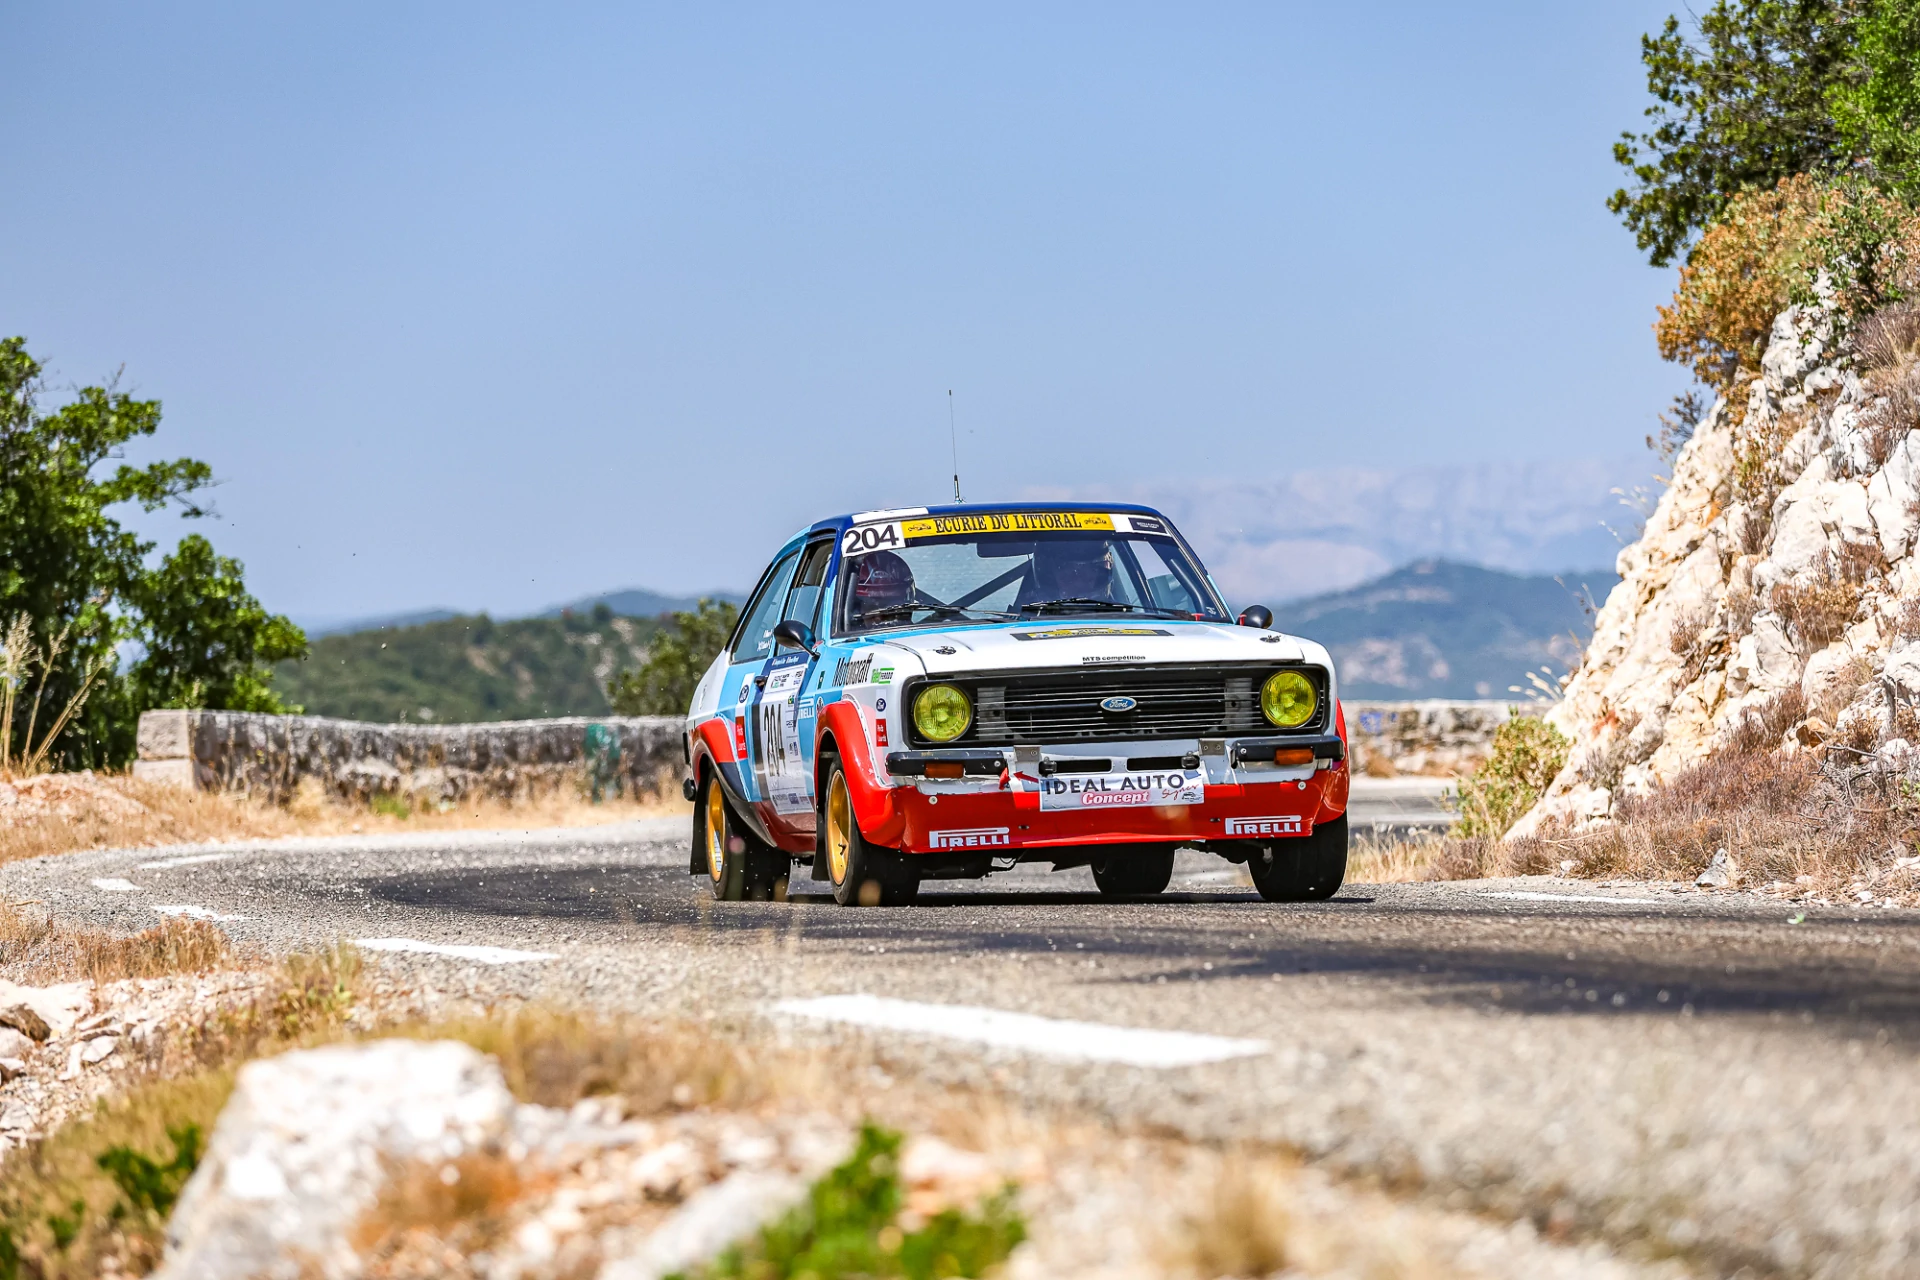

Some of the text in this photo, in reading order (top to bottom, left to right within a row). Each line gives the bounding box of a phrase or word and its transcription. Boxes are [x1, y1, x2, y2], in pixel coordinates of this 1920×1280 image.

[934, 513, 1082, 533] ECURIE DU LITTORAL
[843, 524, 900, 554] 204
[1102, 654, 1146, 662] compétition
[832, 653, 875, 687] Motorcraft
[1045, 774, 1185, 795] IDEAL AUTO
[1082, 791, 1150, 806] Concept
[1224, 814, 1302, 835] PIRELLI
[929, 826, 1010, 848] PIRELLI
